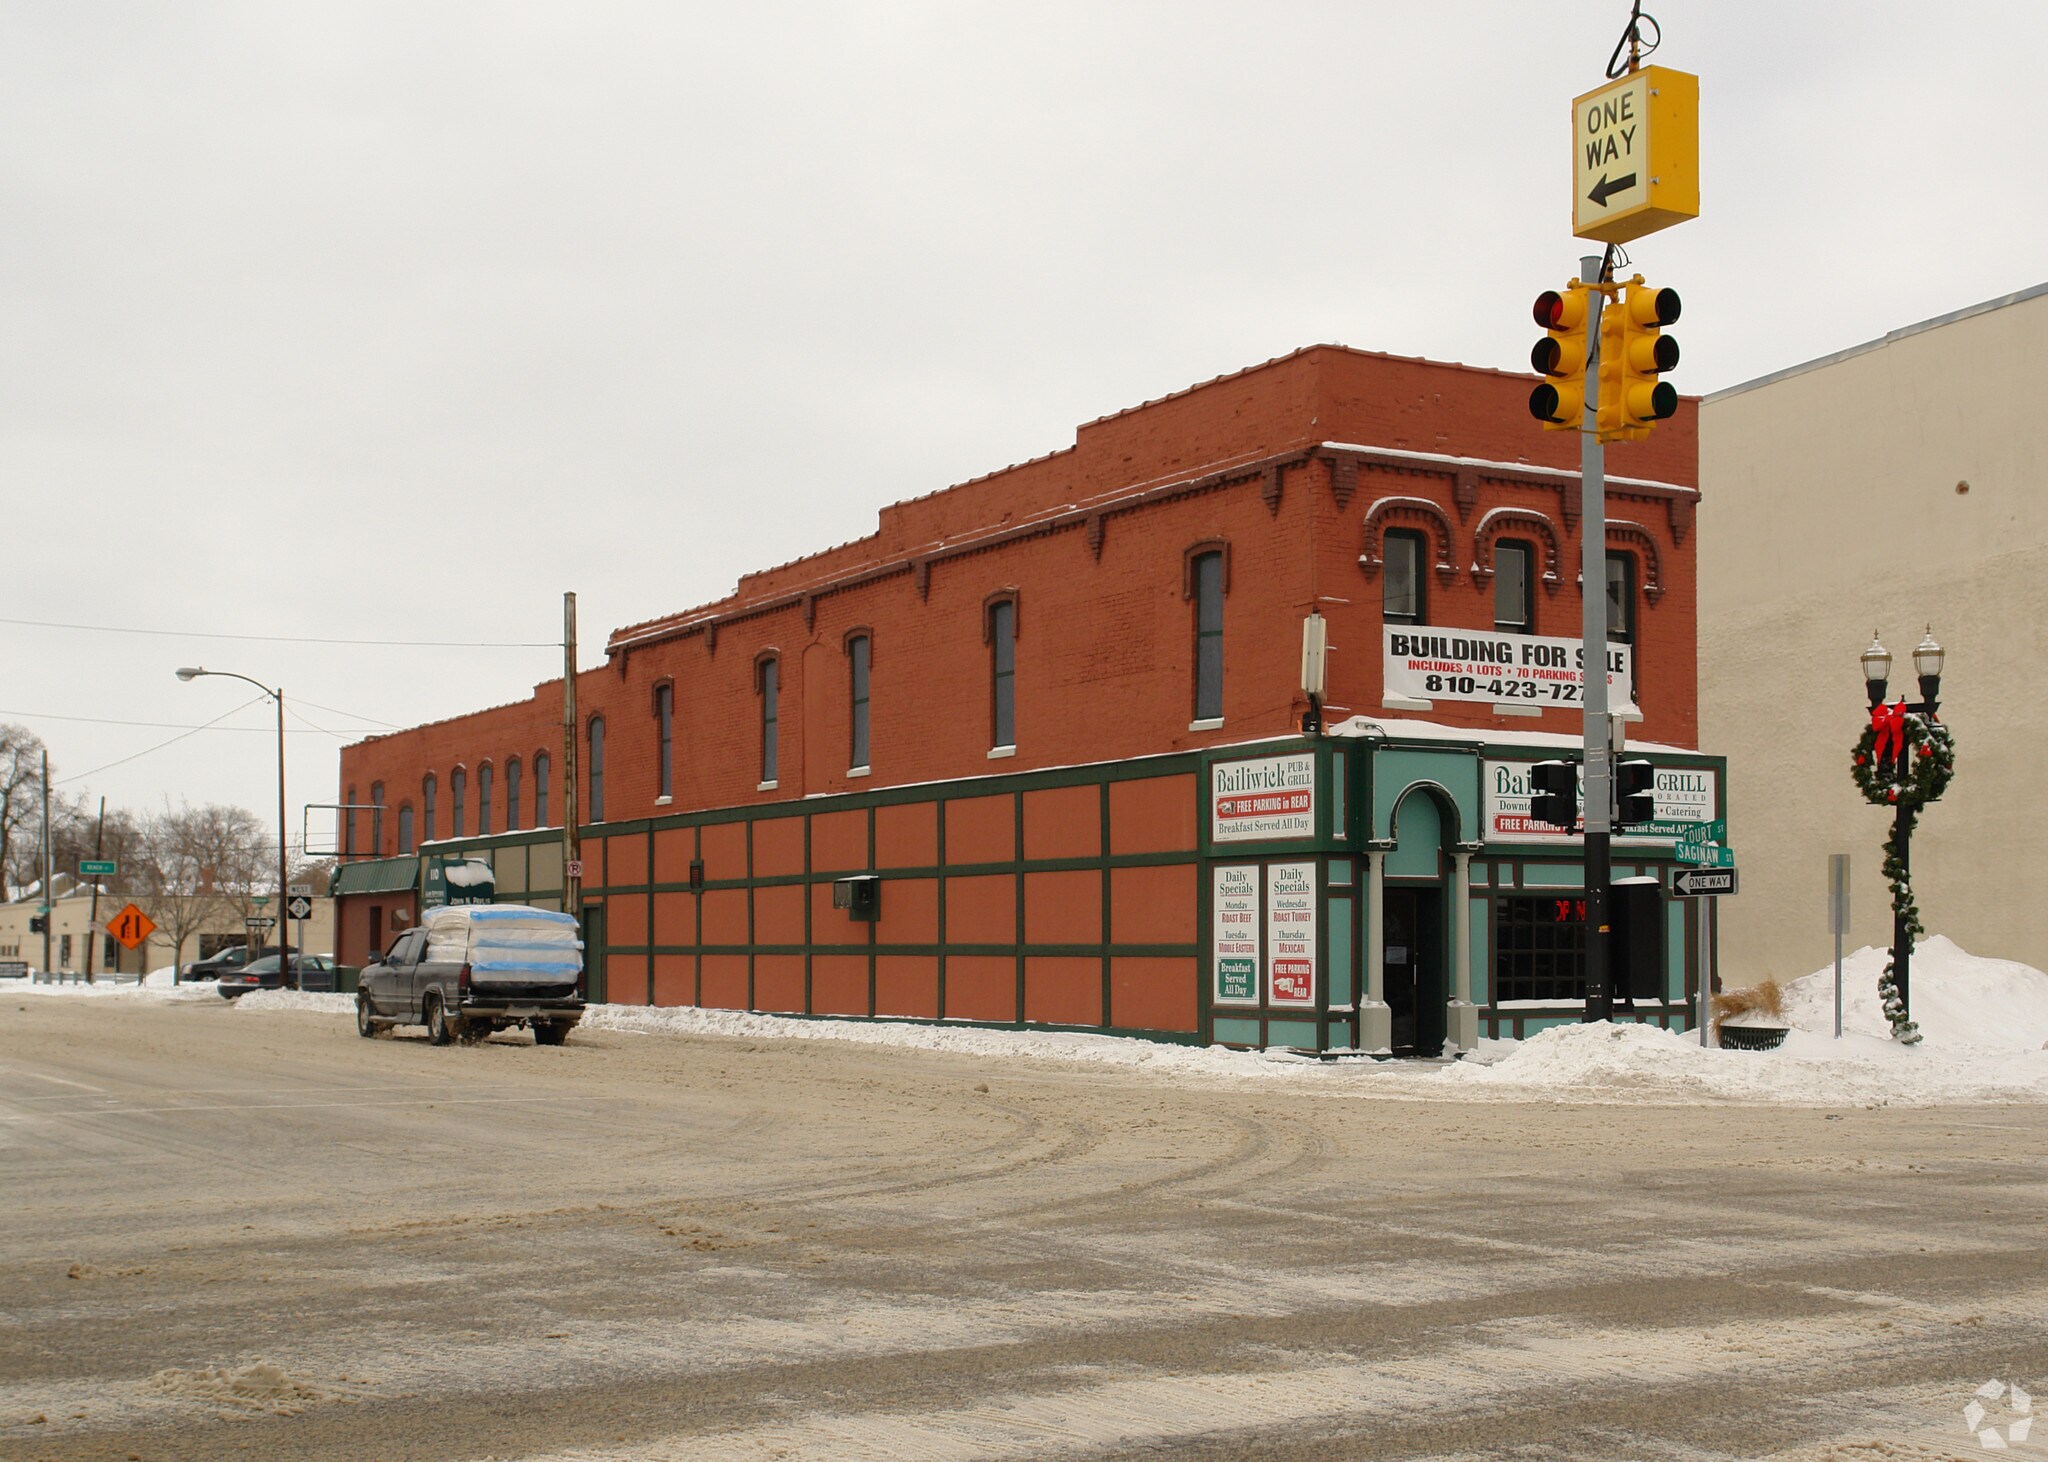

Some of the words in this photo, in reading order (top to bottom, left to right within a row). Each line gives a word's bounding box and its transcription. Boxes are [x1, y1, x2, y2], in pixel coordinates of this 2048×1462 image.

[1588, 90, 1634, 134] ONE
[1586, 124, 1637, 171] WAY
[1391, 634, 1513, 664] BUILDING
[1522, 644, 1567, 668] FOR
[1575, 648, 1624, 673] SLE
[1408, 660, 1463, 674] INCLUDES
[1466, 664, 1473, 674] 4
[1477, 665, 1502, 676] LOTS
[1516, 667, 1529, 678] 70
[1532, 669, 1576, 681] PARKING
[1425, 674, 1584, 701] 810-423-727
[1287, 761, 1304, 773] PUB
[1304, 761, 1310, 771] &
[1217, 763, 1285, 792] Bailiwick
[1287, 774, 1312, 786] GRILL
[1657, 773, 1706, 792] GRILL
[1237, 800, 1252, 813] FREE
[1253, 797, 1281, 811] PARKING
[1282, 797, 1290, 809] in
[1290, 795, 1309, 808] REAR
[1665, 805, 1701, 817] Catering
[1218, 821, 1253, 834] Breakfast
[1254, 820, 1280, 832] Served
[1281, 818, 1293, 830] All
[1294, 818, 1309, 831] Day
[1500, 818, 1520, 830] FREE
[1649, 823, 1675, 833] Served
[1683, 825, 1712, 844] COURT
[1717, 824, 1724, 833] ST
[1678, 844, 1719, 863] SAGINAW
[1725, 853, 1733, 862] ST
[1225, 871, 1247, 884] Daily
[1280, 868, 1303, 881] Daily
[1274, 880, 1310, 894] Specials
[1688, 878, 1706, 888] ONE
[1709, 876, 1728, 886] WAY
[1219, 882, 1253, 896] Specials
[294, 904, 305, 914] 21
[1225, 900, 1248, 911] Monday
[1276, 899, 1307, 910] Wednesday
[1221, 912, 1238, 923] ROAST
[1239, 912, 1252, 923] BEEF
[1273, 912, 1291, 922] ROAST
[1292, 911, 1311, 922] TURKEY
[1225, 930, 1247, 941] Tuesday
[1278, 930, 1306, 940] Thursday
[1278, 943, 1306, 953] MEXICAN
[1221, 962, 1251, 973] Breakfast
[1274, 964, 1287, 974] FREE
[1287, 964, 1310, 974] PARKING
[1225, 973, 1247, 983] Served
[1224, 984, 1234, 995] All
[1234, 984, 1247, 996] Day
[1293, 987, 1307, 997] REAR
